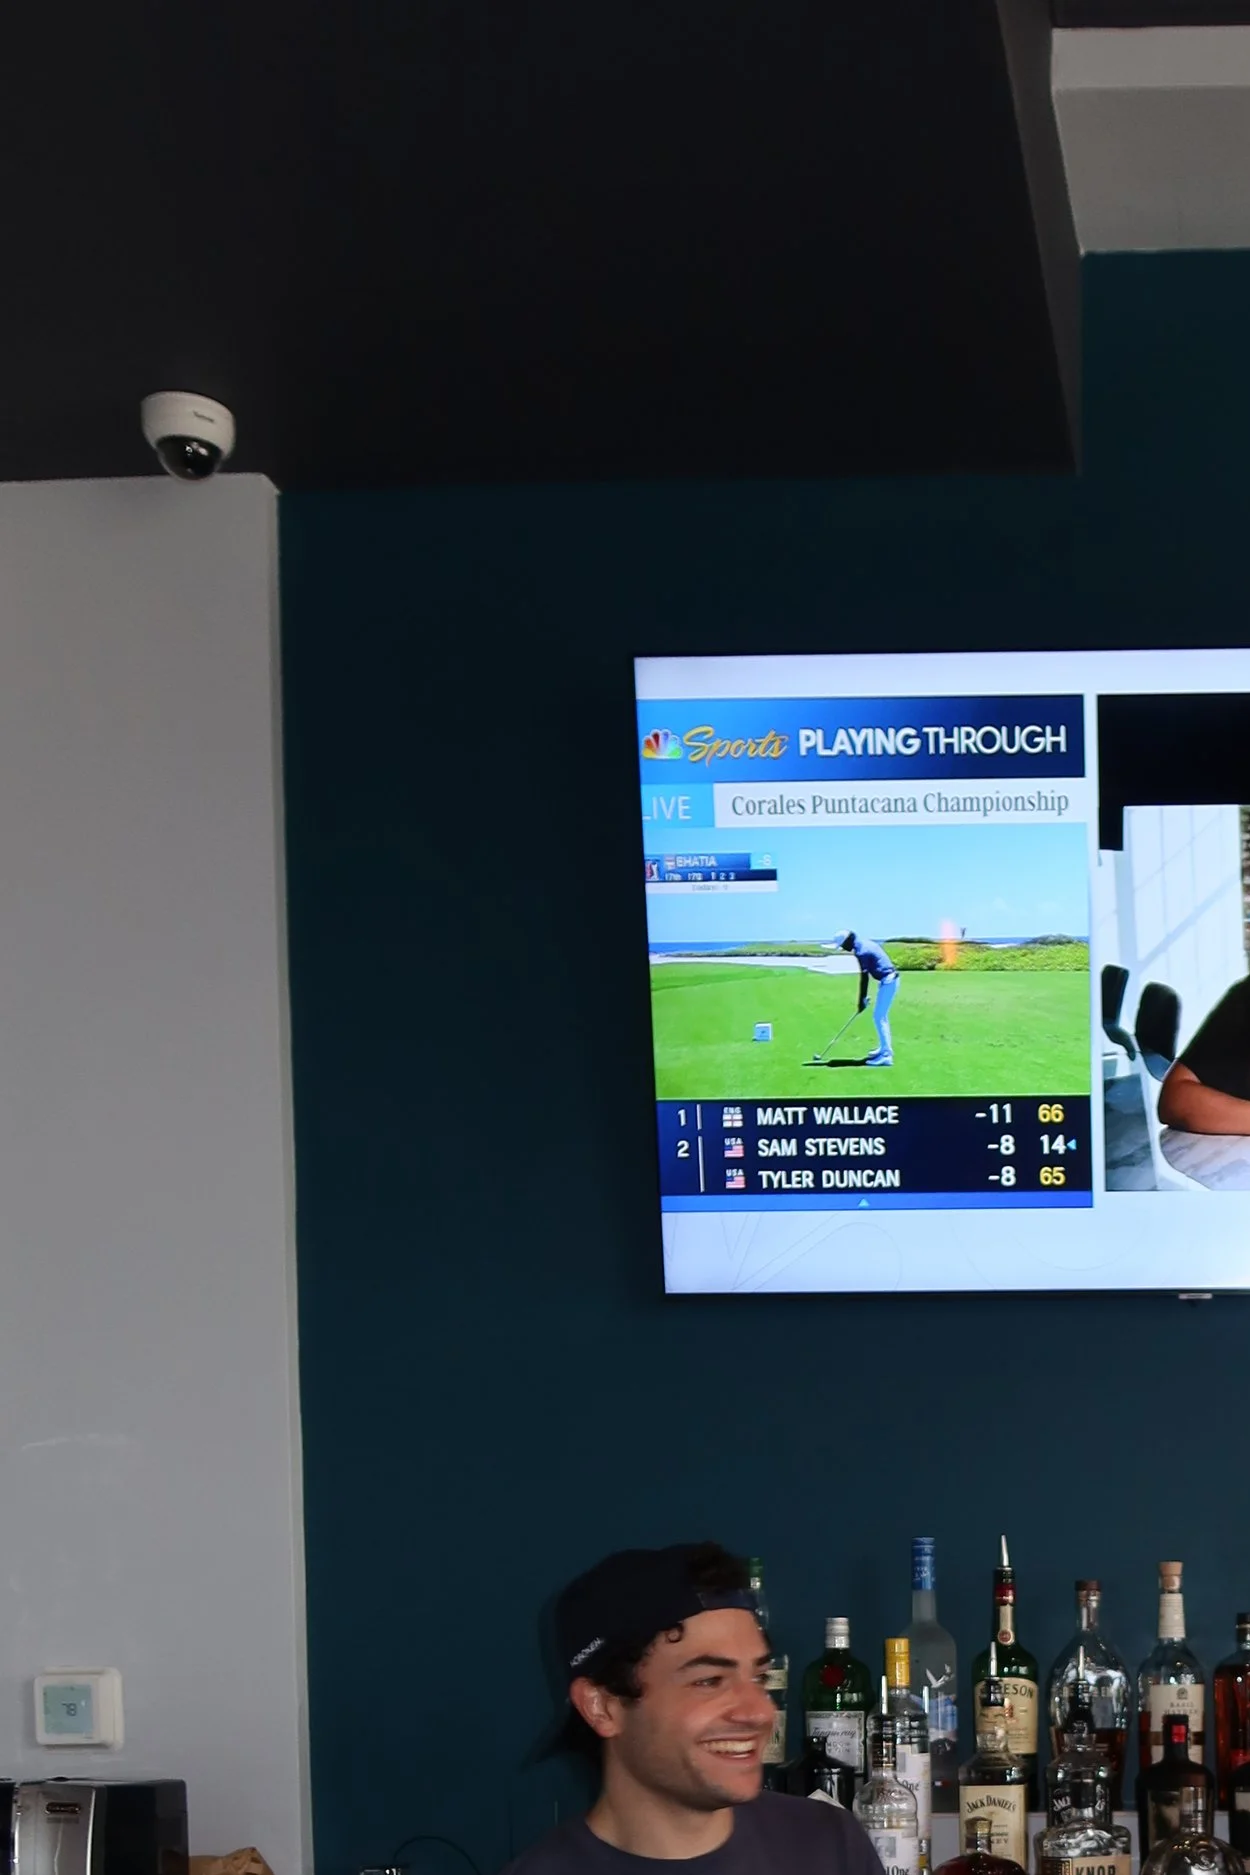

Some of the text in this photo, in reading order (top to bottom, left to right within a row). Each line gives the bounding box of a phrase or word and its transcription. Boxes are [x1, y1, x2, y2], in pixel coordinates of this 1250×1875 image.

[682, 724, 1068, 767] Sports PLAYING THROUGH
[731, 790, 1070, 817] Corales Puntacana Championship
[677, 1109, 688, 1127] 1
[756, 1106, 807, 1126] MATT
[813, 1105, 900, 1125] WALLACE
[974, 1103, 1013, 1123] -11
[1037, 1103, 1066, 1123] 66
[677, 1134, 1066, 1158] 2 USA SAM STEVENS -8 14
[725, 1166, 1066, 1189] USA TYLER DUNCAN -8 65
